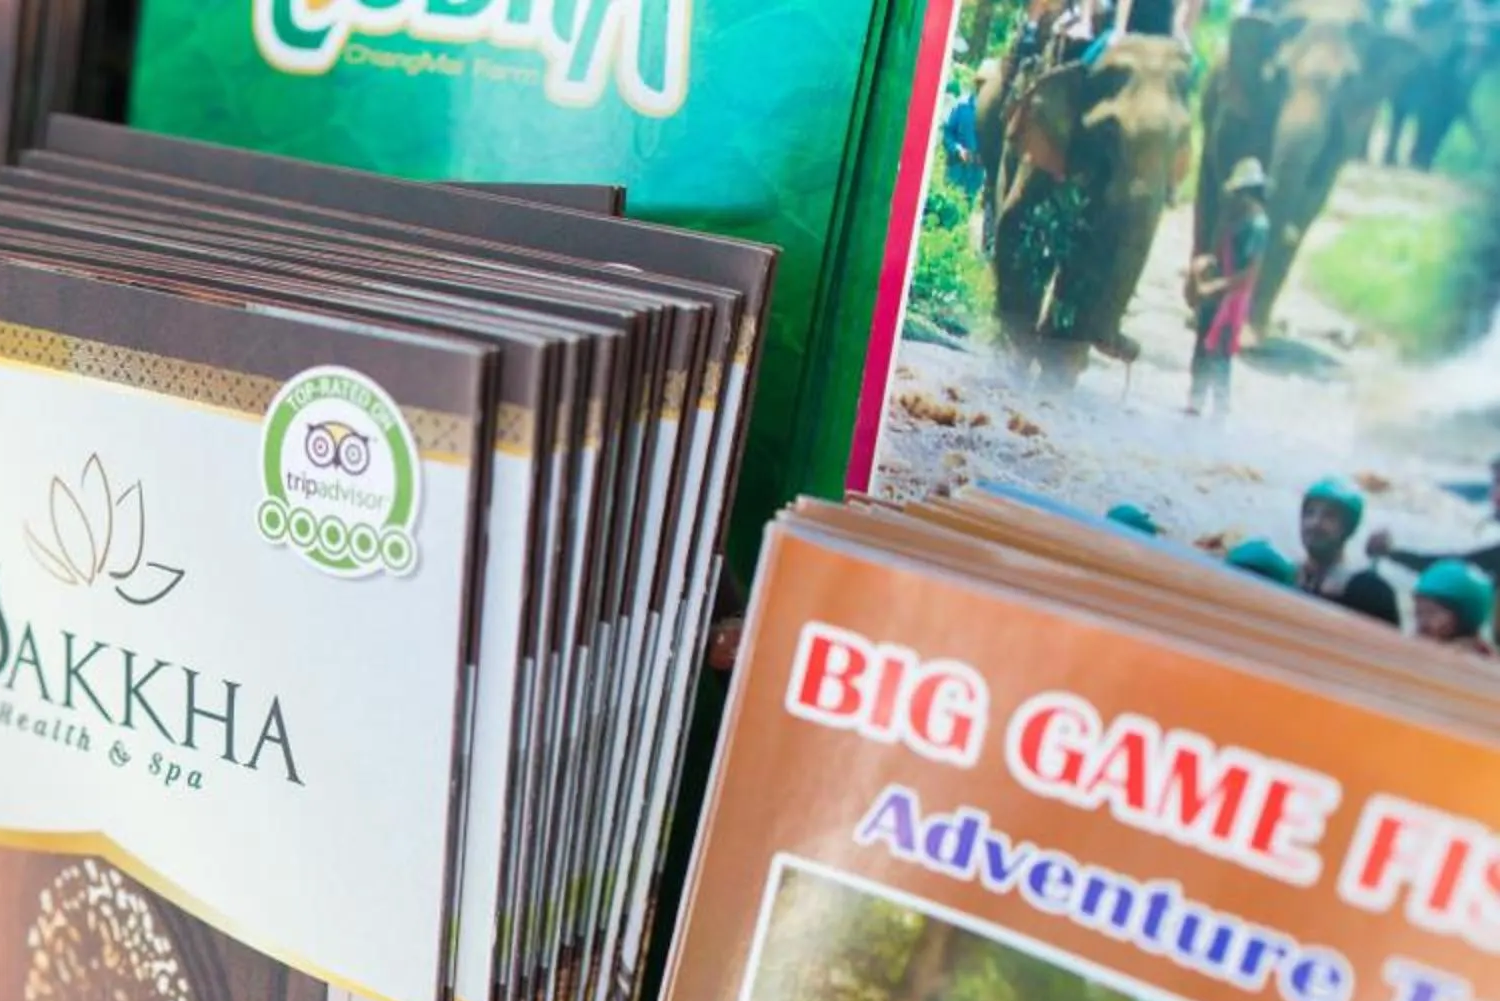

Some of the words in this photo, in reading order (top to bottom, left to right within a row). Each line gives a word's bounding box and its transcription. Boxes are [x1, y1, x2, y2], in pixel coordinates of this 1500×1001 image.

[286, 470, 386, 511] tripadvisor
[107, 740, 132, 768] &
[147, 750, 204, 791] Spa
[785, 620, 990, 768] BIG
[1007, 690, 1342, 887] GAME
